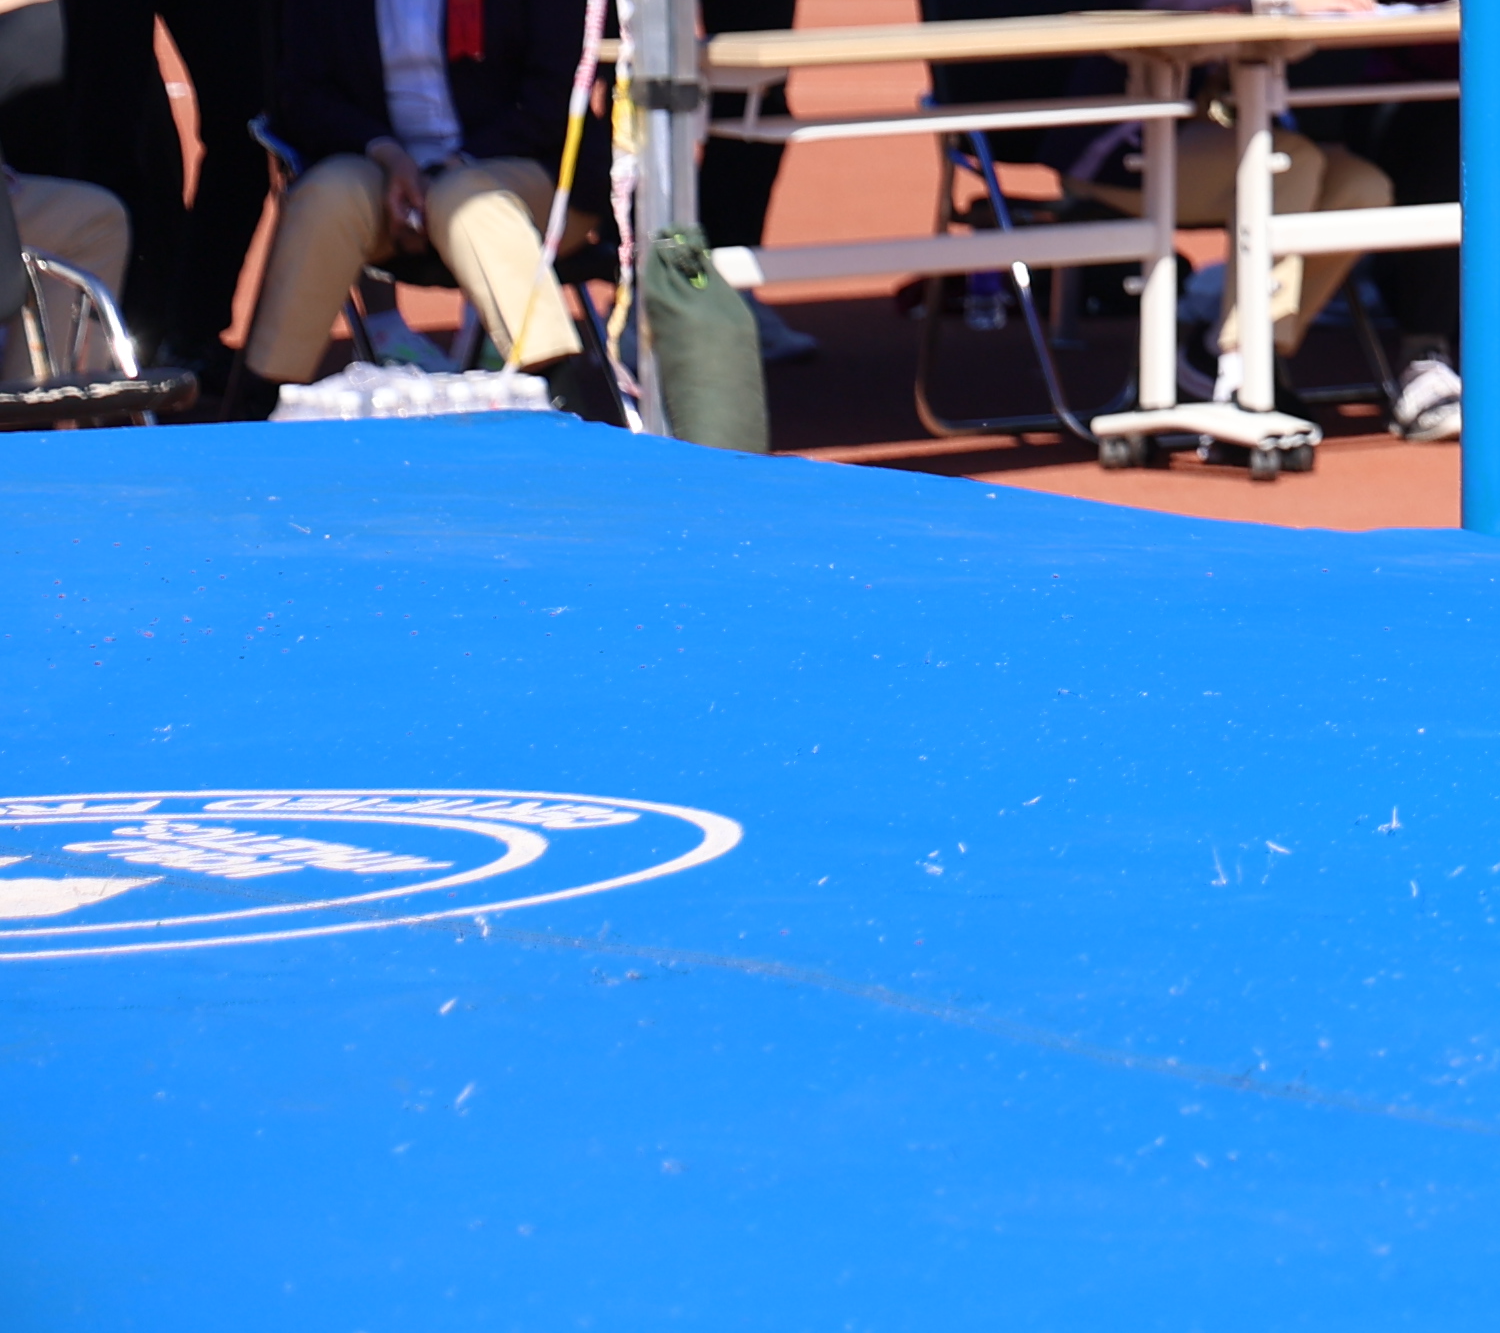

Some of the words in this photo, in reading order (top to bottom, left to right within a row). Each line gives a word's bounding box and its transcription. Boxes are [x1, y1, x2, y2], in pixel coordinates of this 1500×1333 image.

[0, 800, 162, 817] PR
[203, 796, 640, 830] CERTIFIED
[62, 840, 304, 879] WORLD
[111, 819, 455, 874] ATHLETICS
